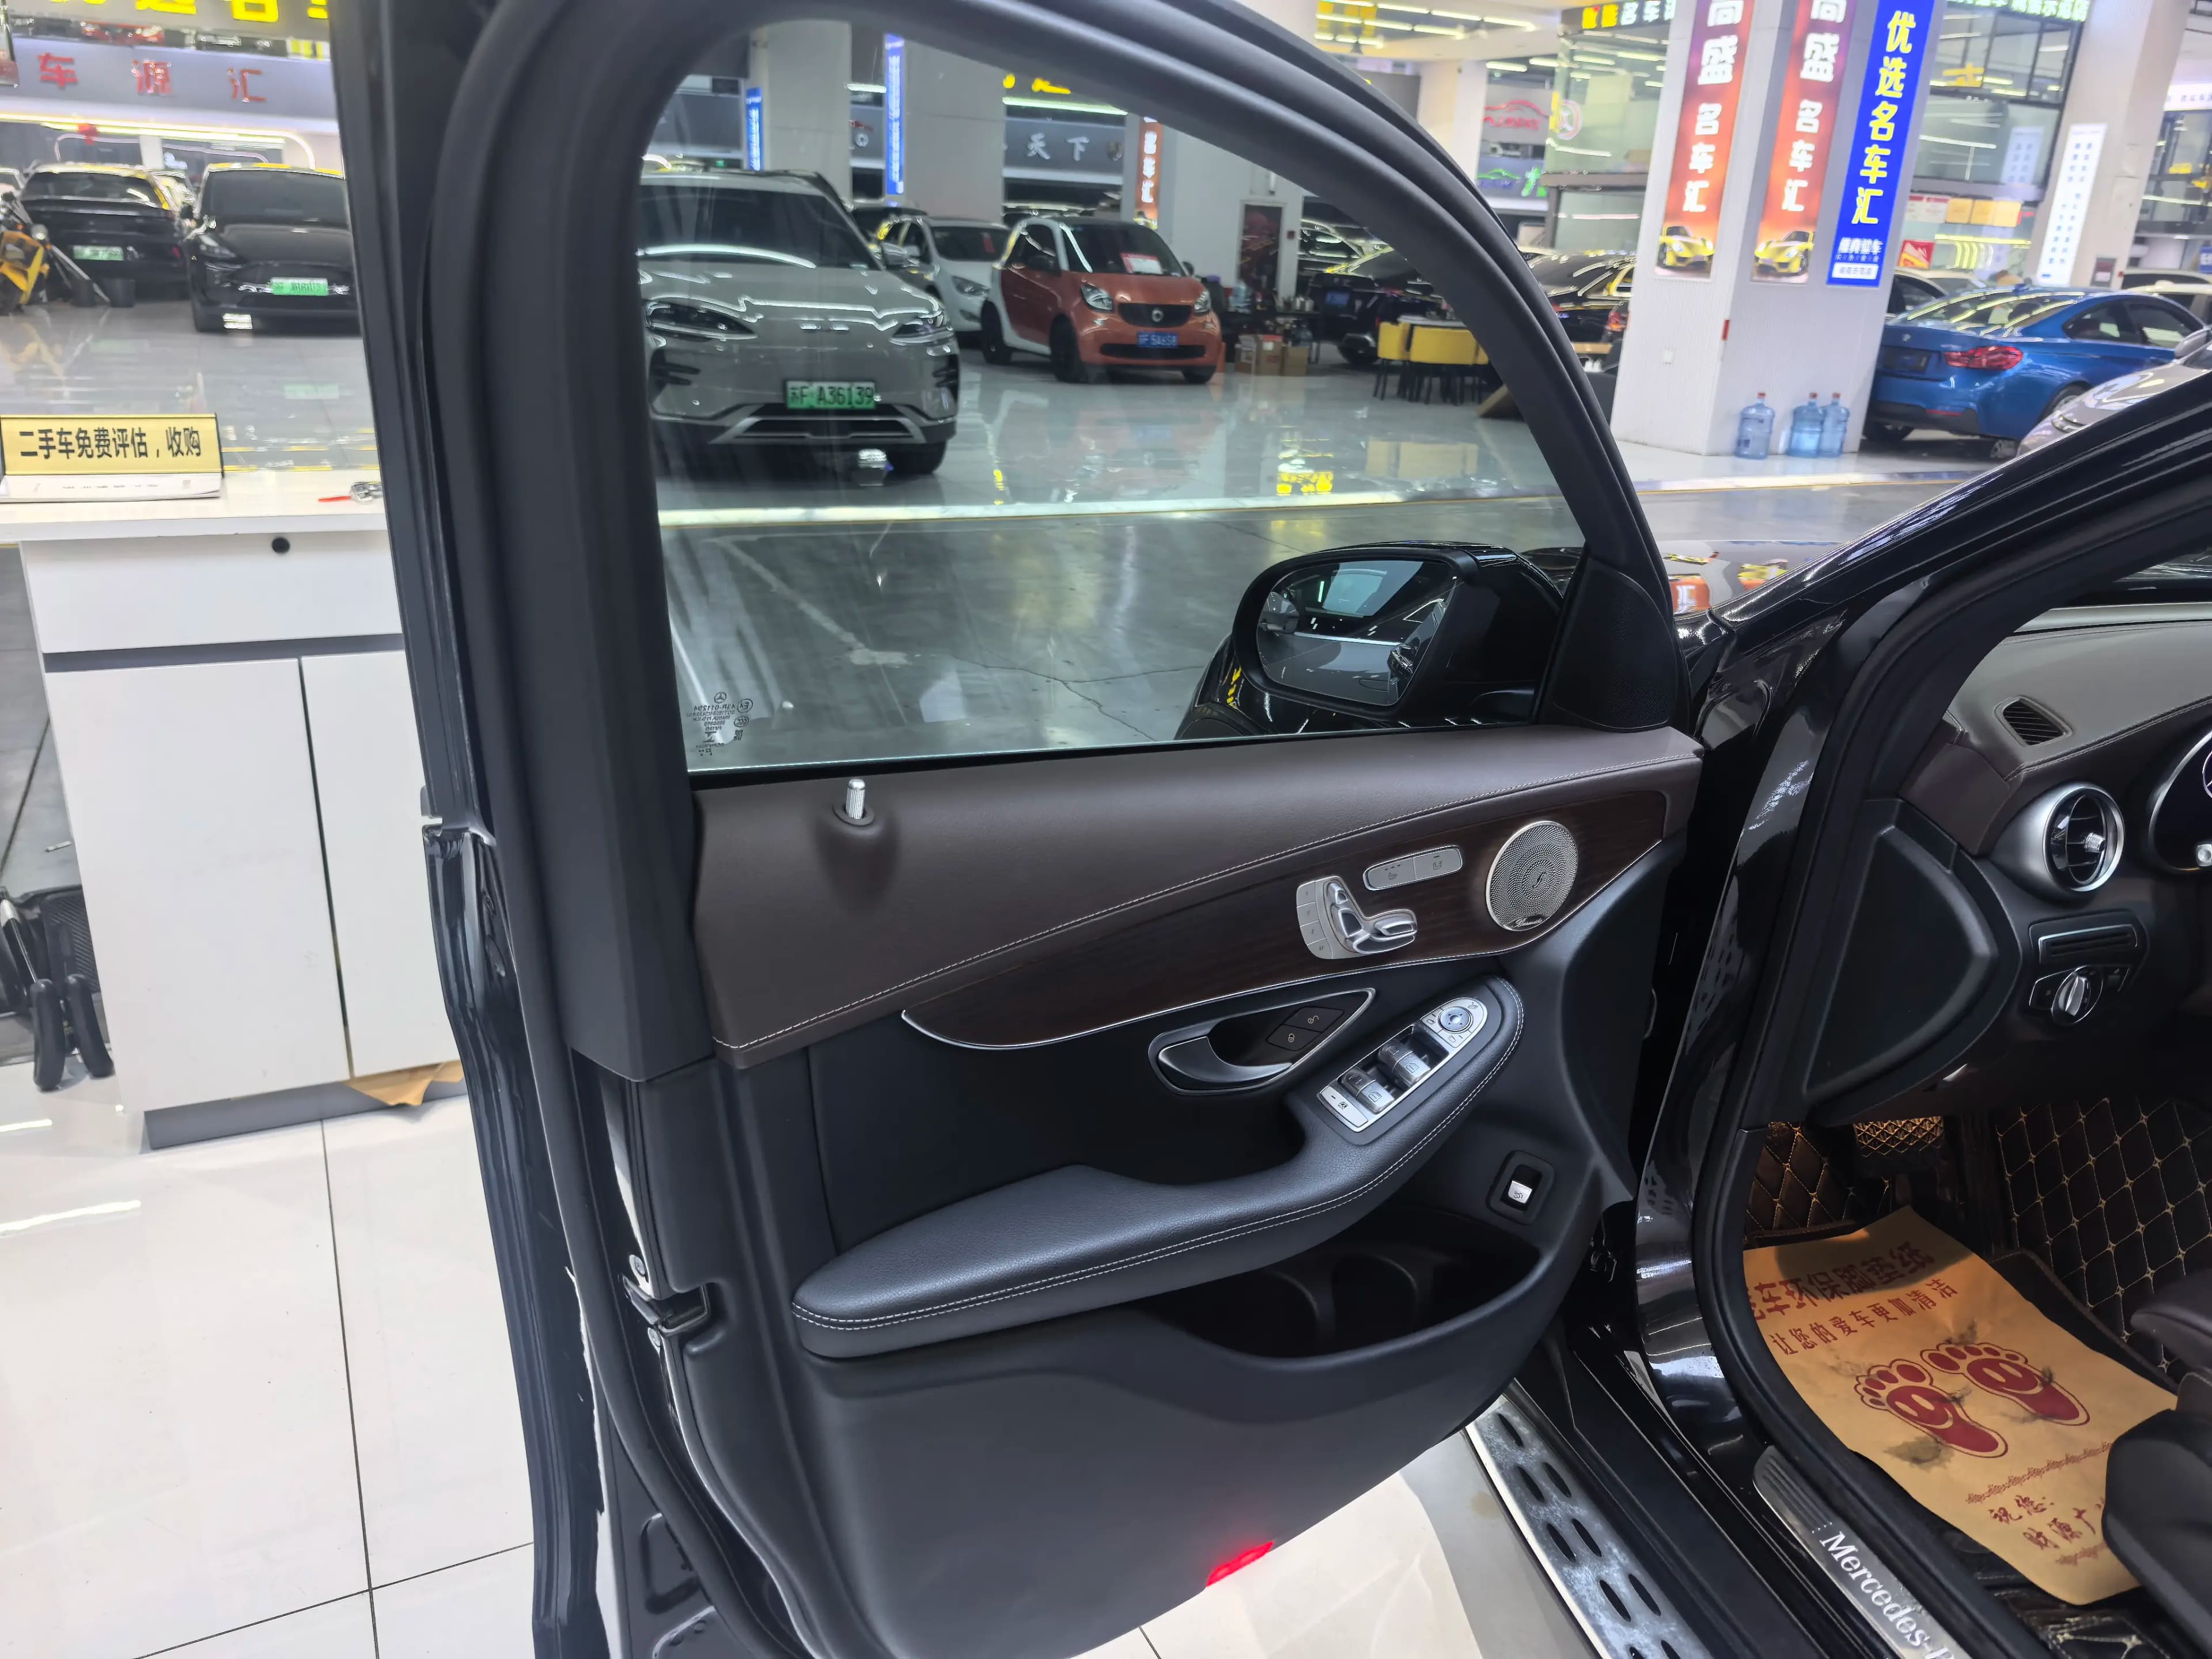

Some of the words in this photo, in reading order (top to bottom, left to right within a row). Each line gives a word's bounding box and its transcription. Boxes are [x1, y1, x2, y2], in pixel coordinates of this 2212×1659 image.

[1851, 10, 1916, 225] 优选名车汇
[1768, 1278, 1959, 1356] 让您的爱车更加清洁
